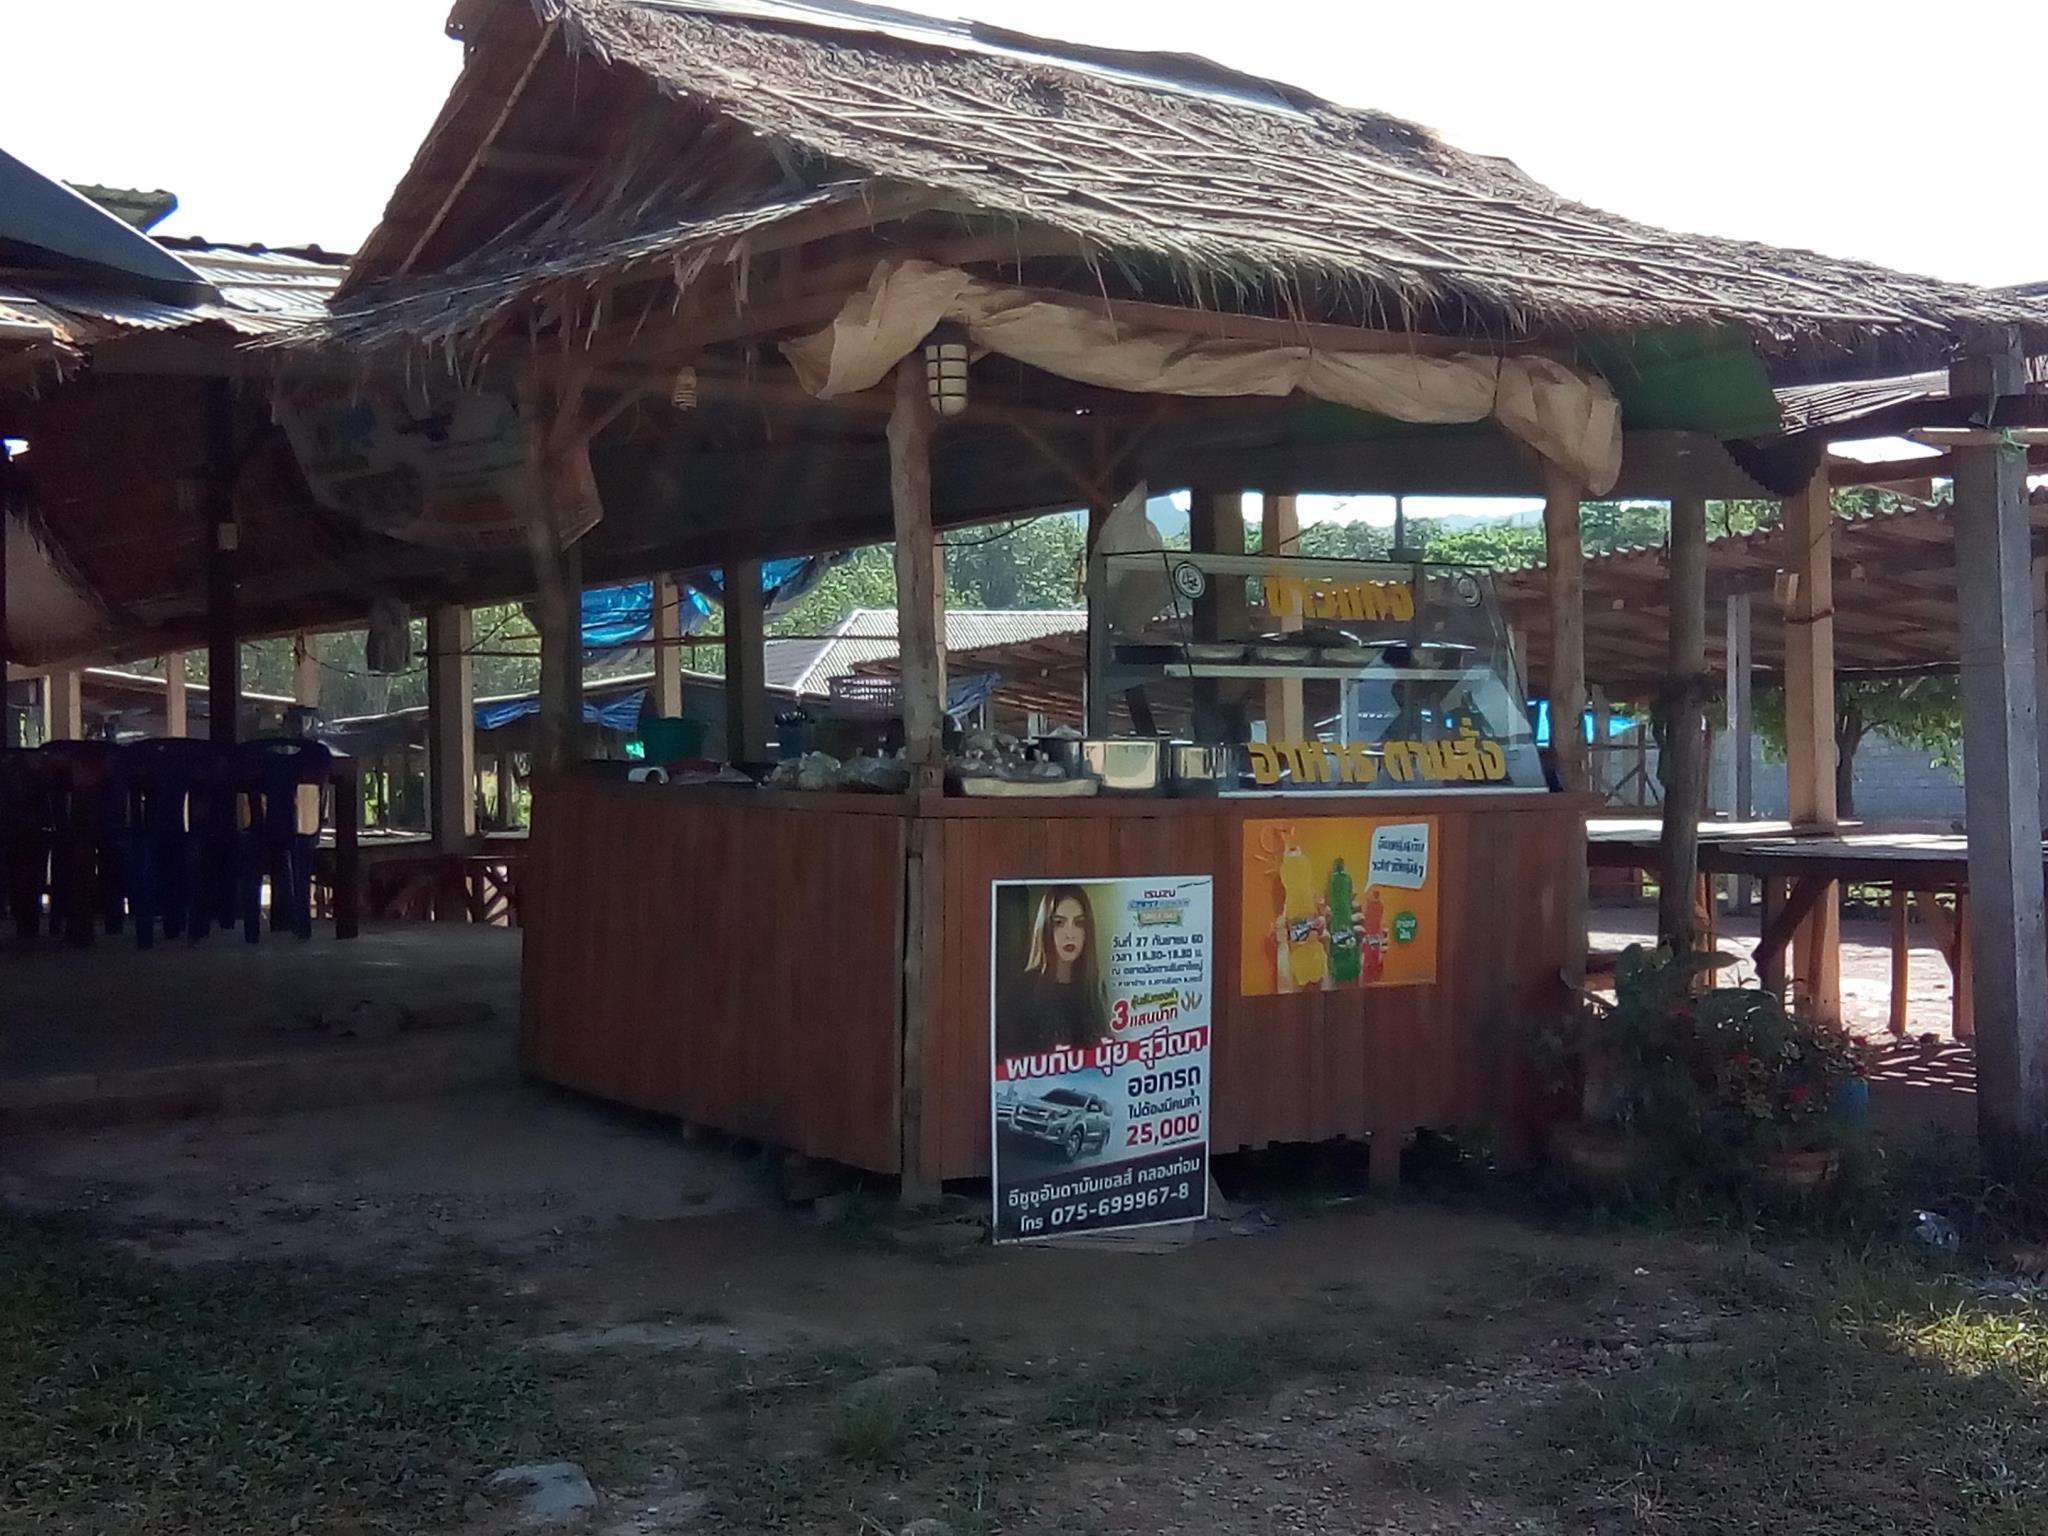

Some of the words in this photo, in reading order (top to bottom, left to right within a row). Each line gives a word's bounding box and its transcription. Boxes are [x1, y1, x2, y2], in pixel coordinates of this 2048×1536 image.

[1248, 740, 1378, 784] อาหาร
[1383, 717, 1506, 781] ตามสั่ง
[1111, 952, 1132, 962] เวลา
[1112, 1000, 1129, 1030] 3
[1130, 1007, 1178, 1027] แสนบาท
[1006, 1043, 1085, 1080] พบกับ
[1095, 1037, 1129, 1075] นุ้ย
[1139, 1026, 1201, 1068] สุวีณา
[1128, 1066, 1201, 1097] ออกรถ
[1137, 1156, 1201, 1184] คลองท่อม
[1020, 1215, 1043, 1232] โทร
[1051, 1182, 1189, 1225] 075-699967-8
